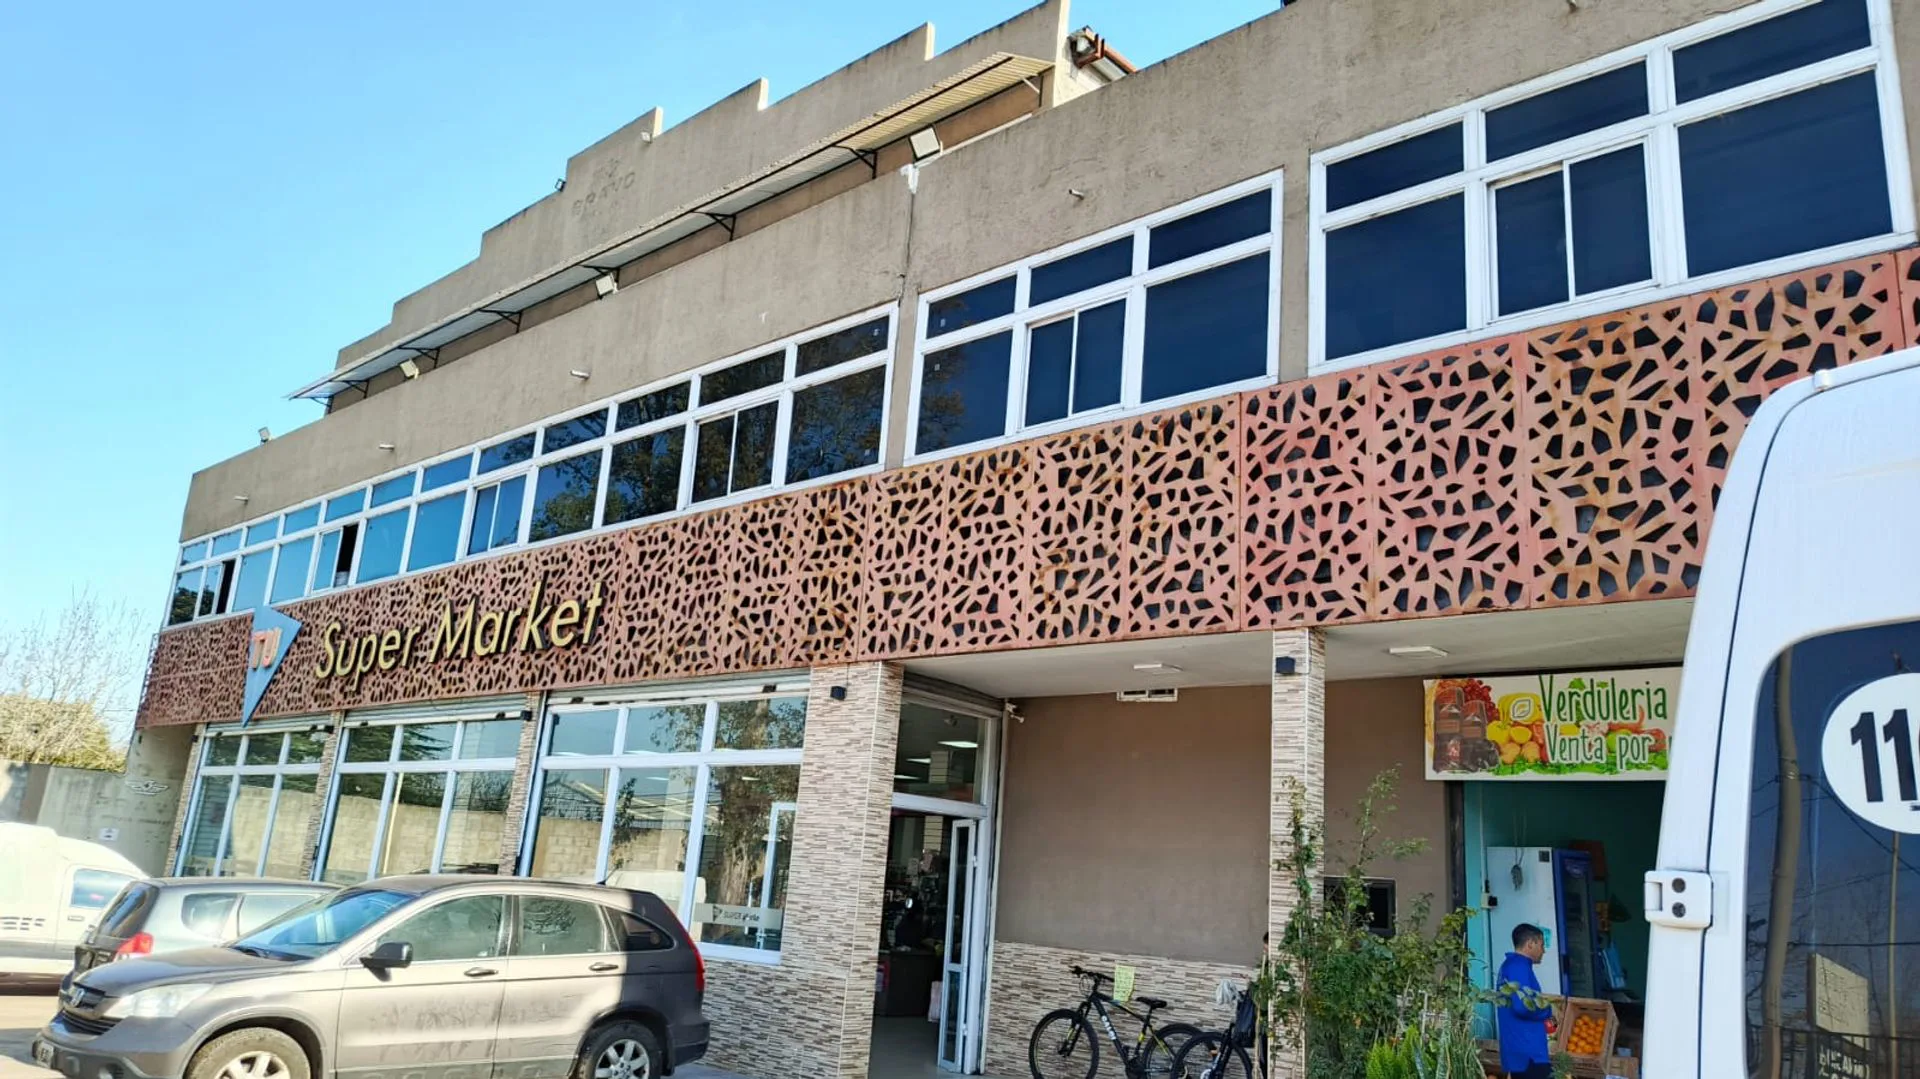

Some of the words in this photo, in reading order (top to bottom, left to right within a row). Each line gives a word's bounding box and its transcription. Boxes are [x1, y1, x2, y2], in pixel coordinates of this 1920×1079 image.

[315, 621, 421, 692] Super
[428, 580, 603, 664] Market
[1539, 674, 1667, 723] Verduleria
[1546, 725, 1604, 762] Venta
[1619, 734, 1650, 769] por
[1850, 708, 1920, 803] 11
